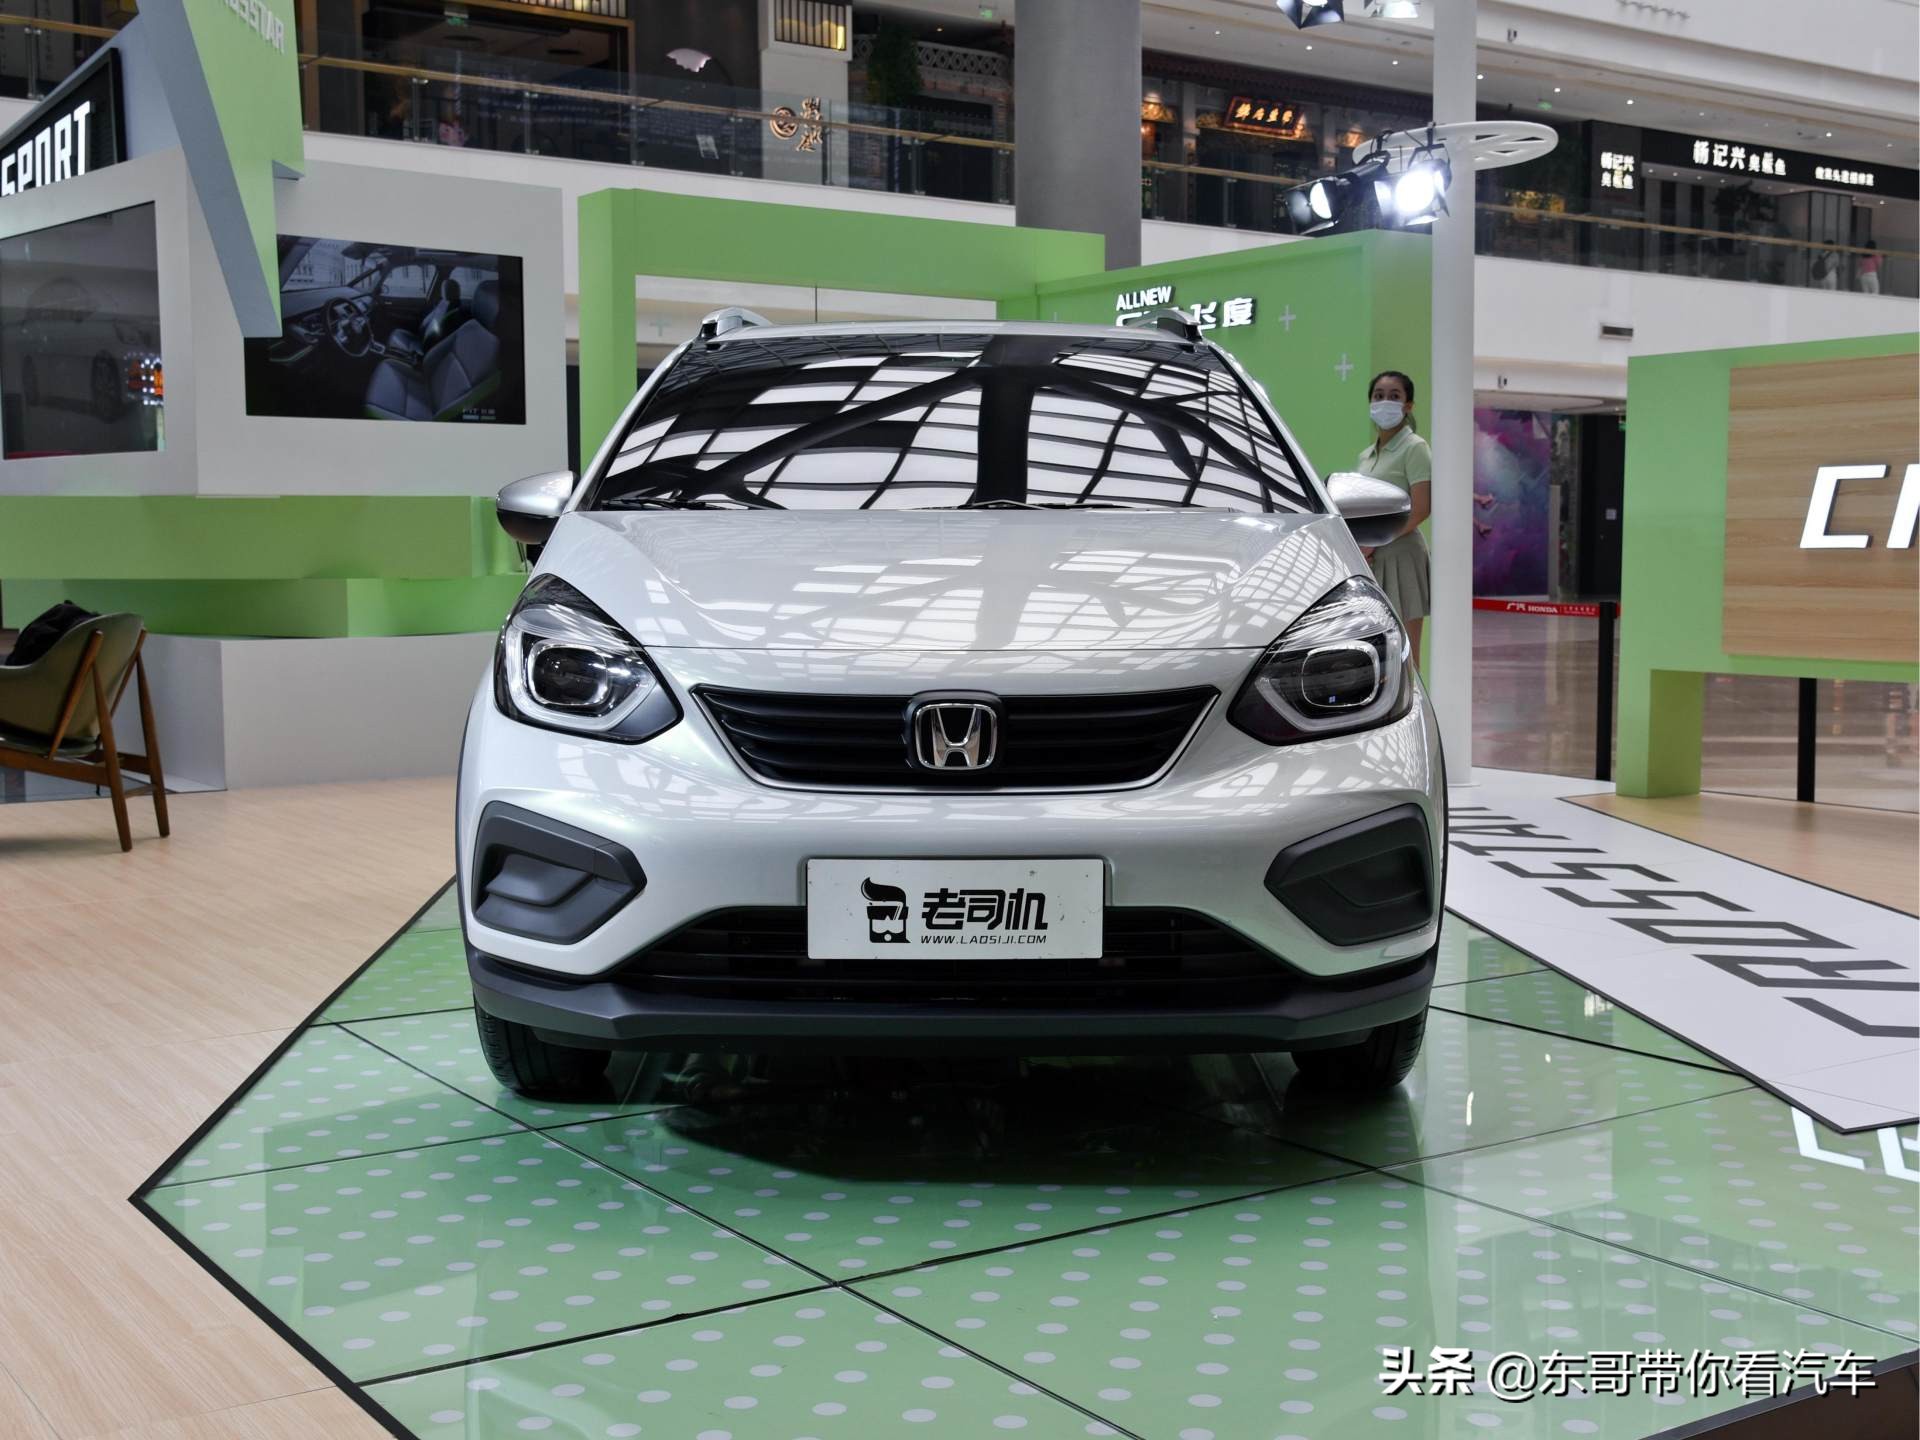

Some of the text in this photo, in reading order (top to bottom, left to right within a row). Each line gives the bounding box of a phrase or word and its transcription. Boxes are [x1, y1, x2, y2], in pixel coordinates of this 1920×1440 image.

[1190, 298, 1253, 330] 飞度
[1528, 606, 1558, 614] HONDA
[921, 888, 1048, 930] 老司机
[920, 935, 1047, 944] WWW.LAOSIJI.COM
